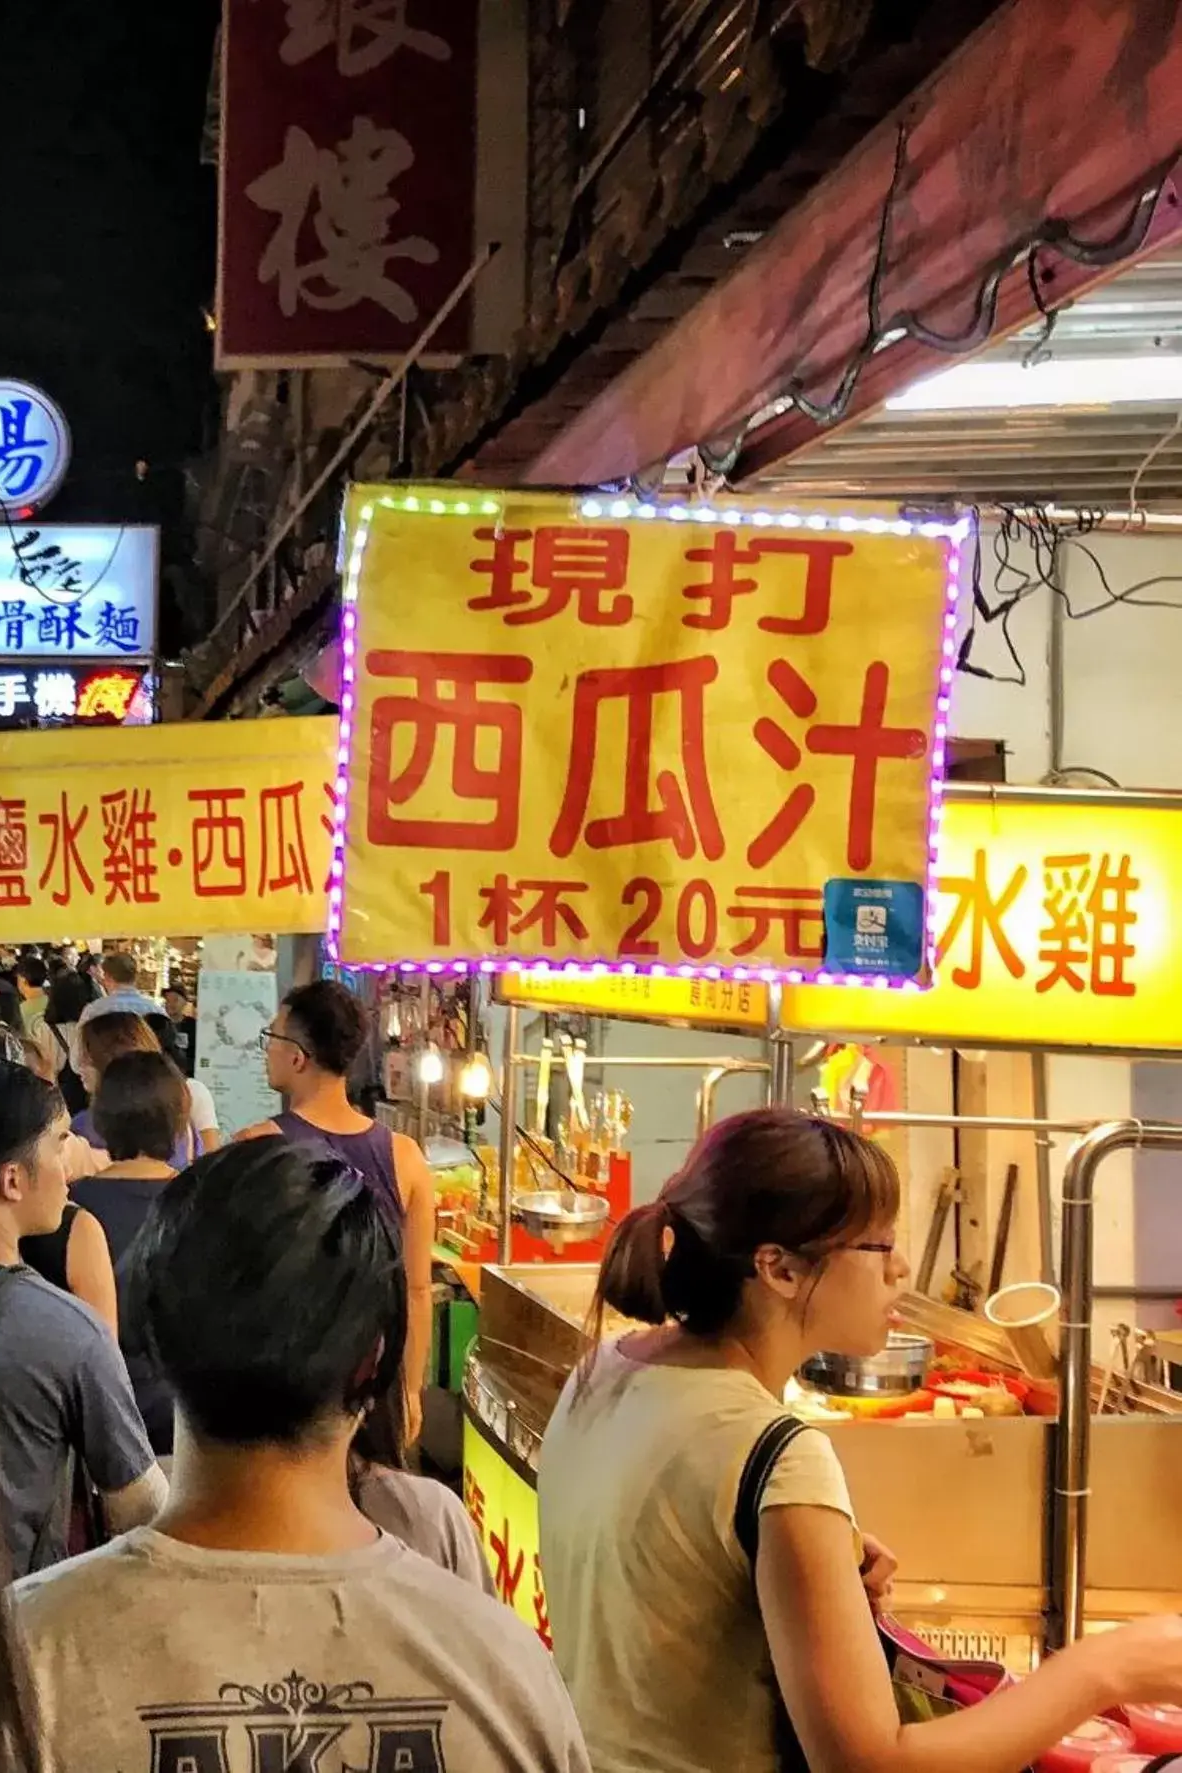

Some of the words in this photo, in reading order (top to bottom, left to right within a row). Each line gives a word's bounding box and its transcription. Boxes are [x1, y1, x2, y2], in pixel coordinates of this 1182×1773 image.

[467, 526, 854, 635] 現打
[366, 649, 928, 872] 西瓜汁
[934, 848, 1140, 997] 水雞
